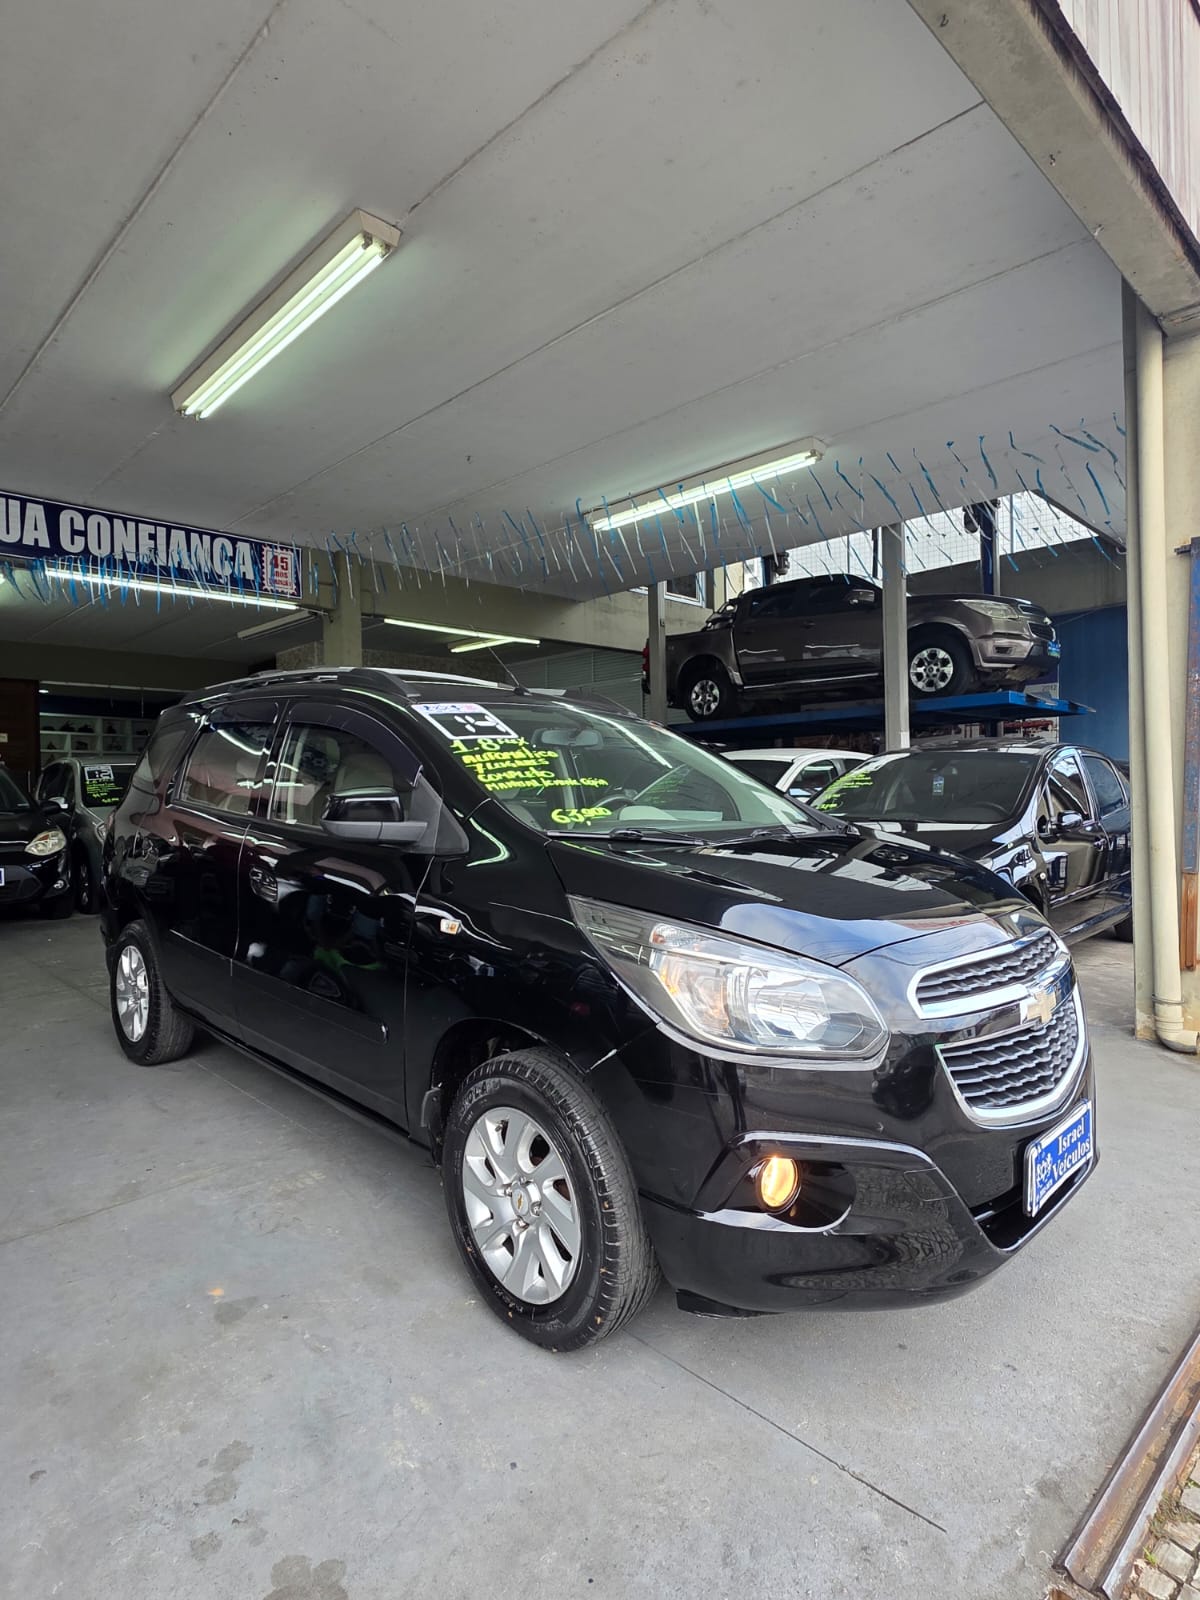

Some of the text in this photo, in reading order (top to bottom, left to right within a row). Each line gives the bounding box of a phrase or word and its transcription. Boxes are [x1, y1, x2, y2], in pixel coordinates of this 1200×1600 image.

[450, 738, 500, 754] 1.8
[1058, 1118, 1085, 1154] Israel
[1052, 1139, 1090, 1180] Veículos
